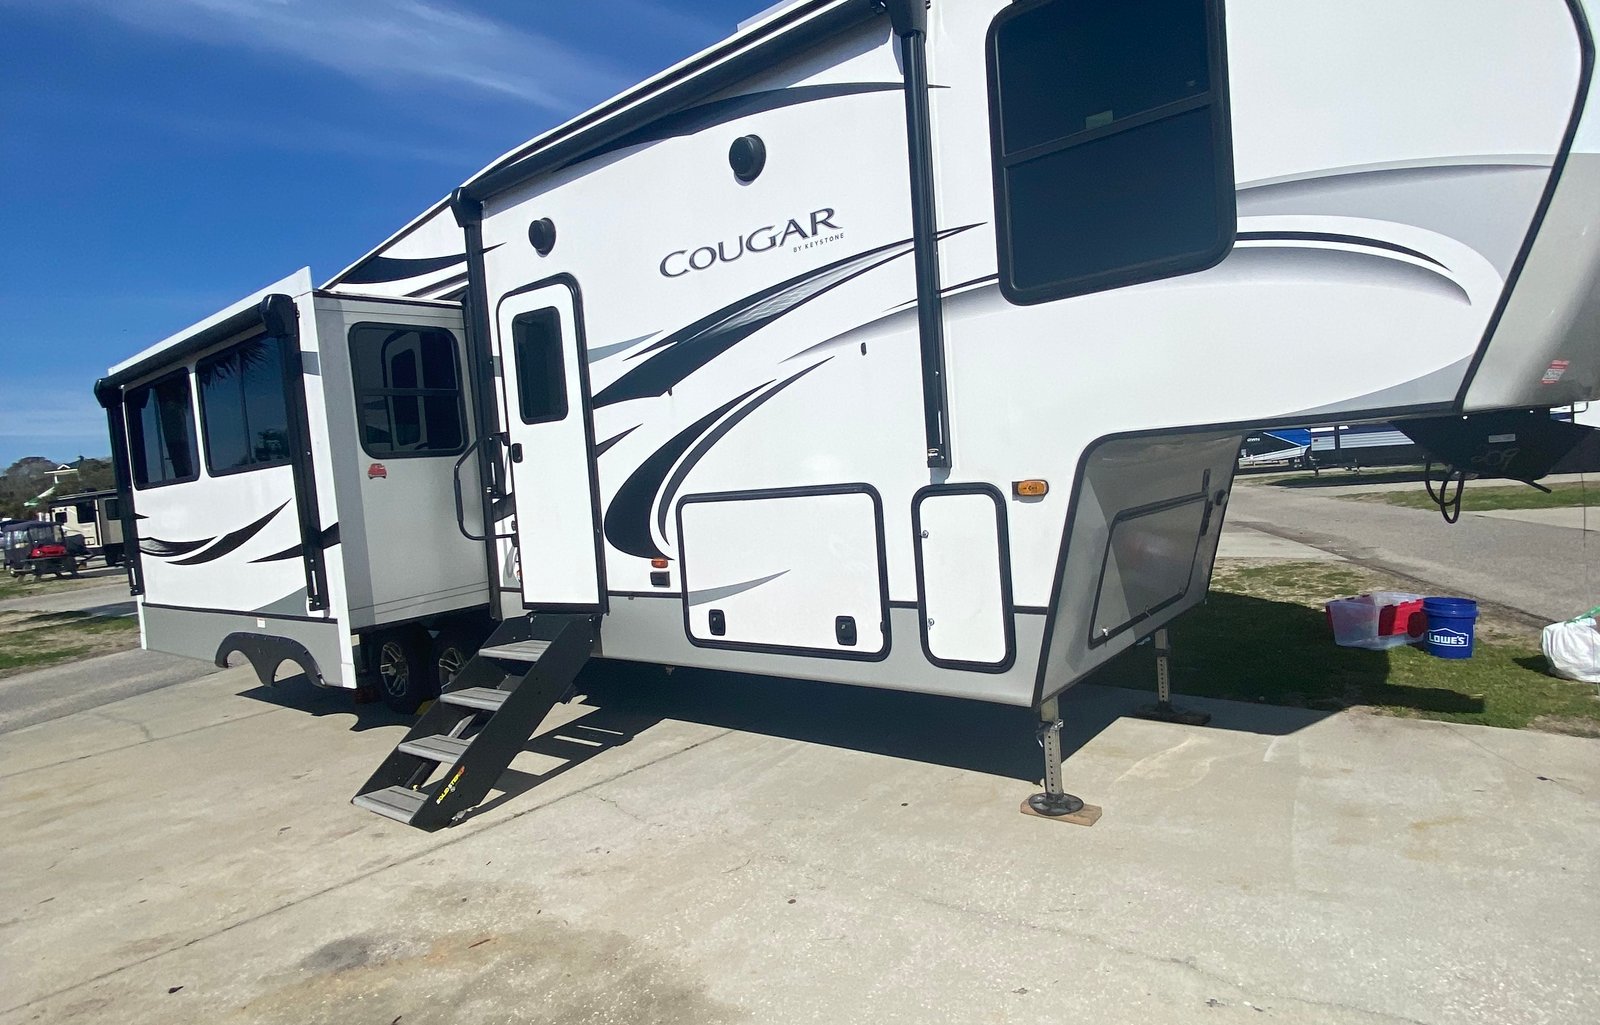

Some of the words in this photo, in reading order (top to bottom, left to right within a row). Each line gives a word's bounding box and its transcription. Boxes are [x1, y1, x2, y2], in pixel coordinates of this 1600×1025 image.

[659, 207, 843, 278] COUGAR
[793, 245, 802, 253] BY
[804, 232, 844, 249] KEYSTONE
[1429, 632, 1466, 645] LOWE'S
